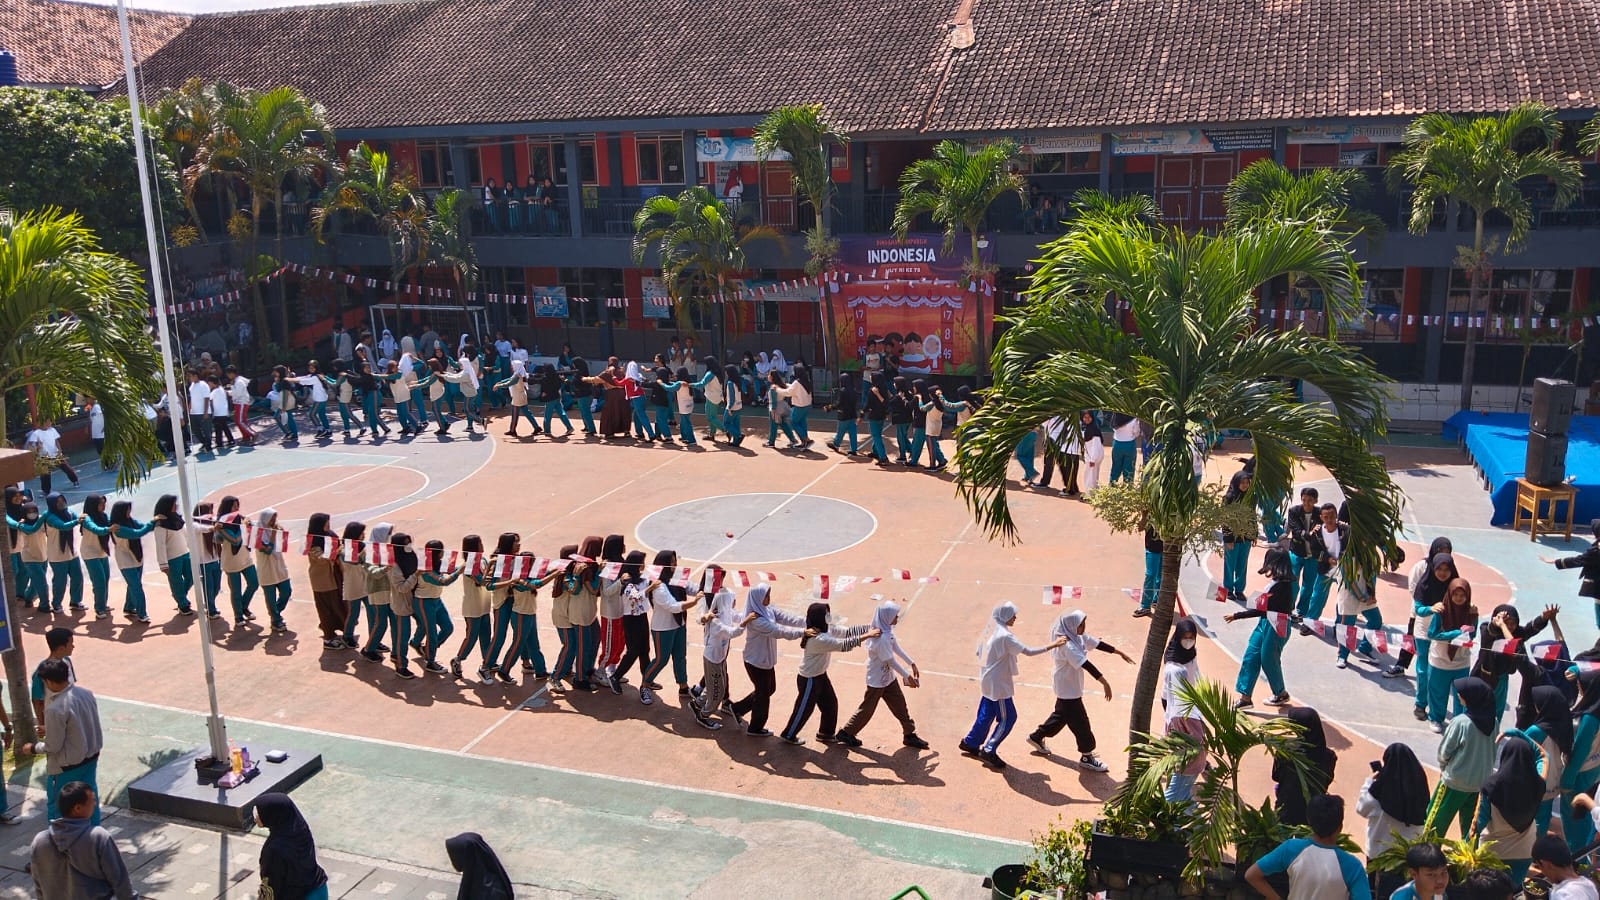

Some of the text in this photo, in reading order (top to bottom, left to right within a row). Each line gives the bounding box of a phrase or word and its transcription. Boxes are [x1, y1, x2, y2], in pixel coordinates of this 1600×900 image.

[867, 248, 936, 264] INDONESIA
[855, 309, 864, 320] 17
[943, 310, 952, 321] 17
[858, 326, 864, 337] 8
[944, 328, 951, 340] 8
